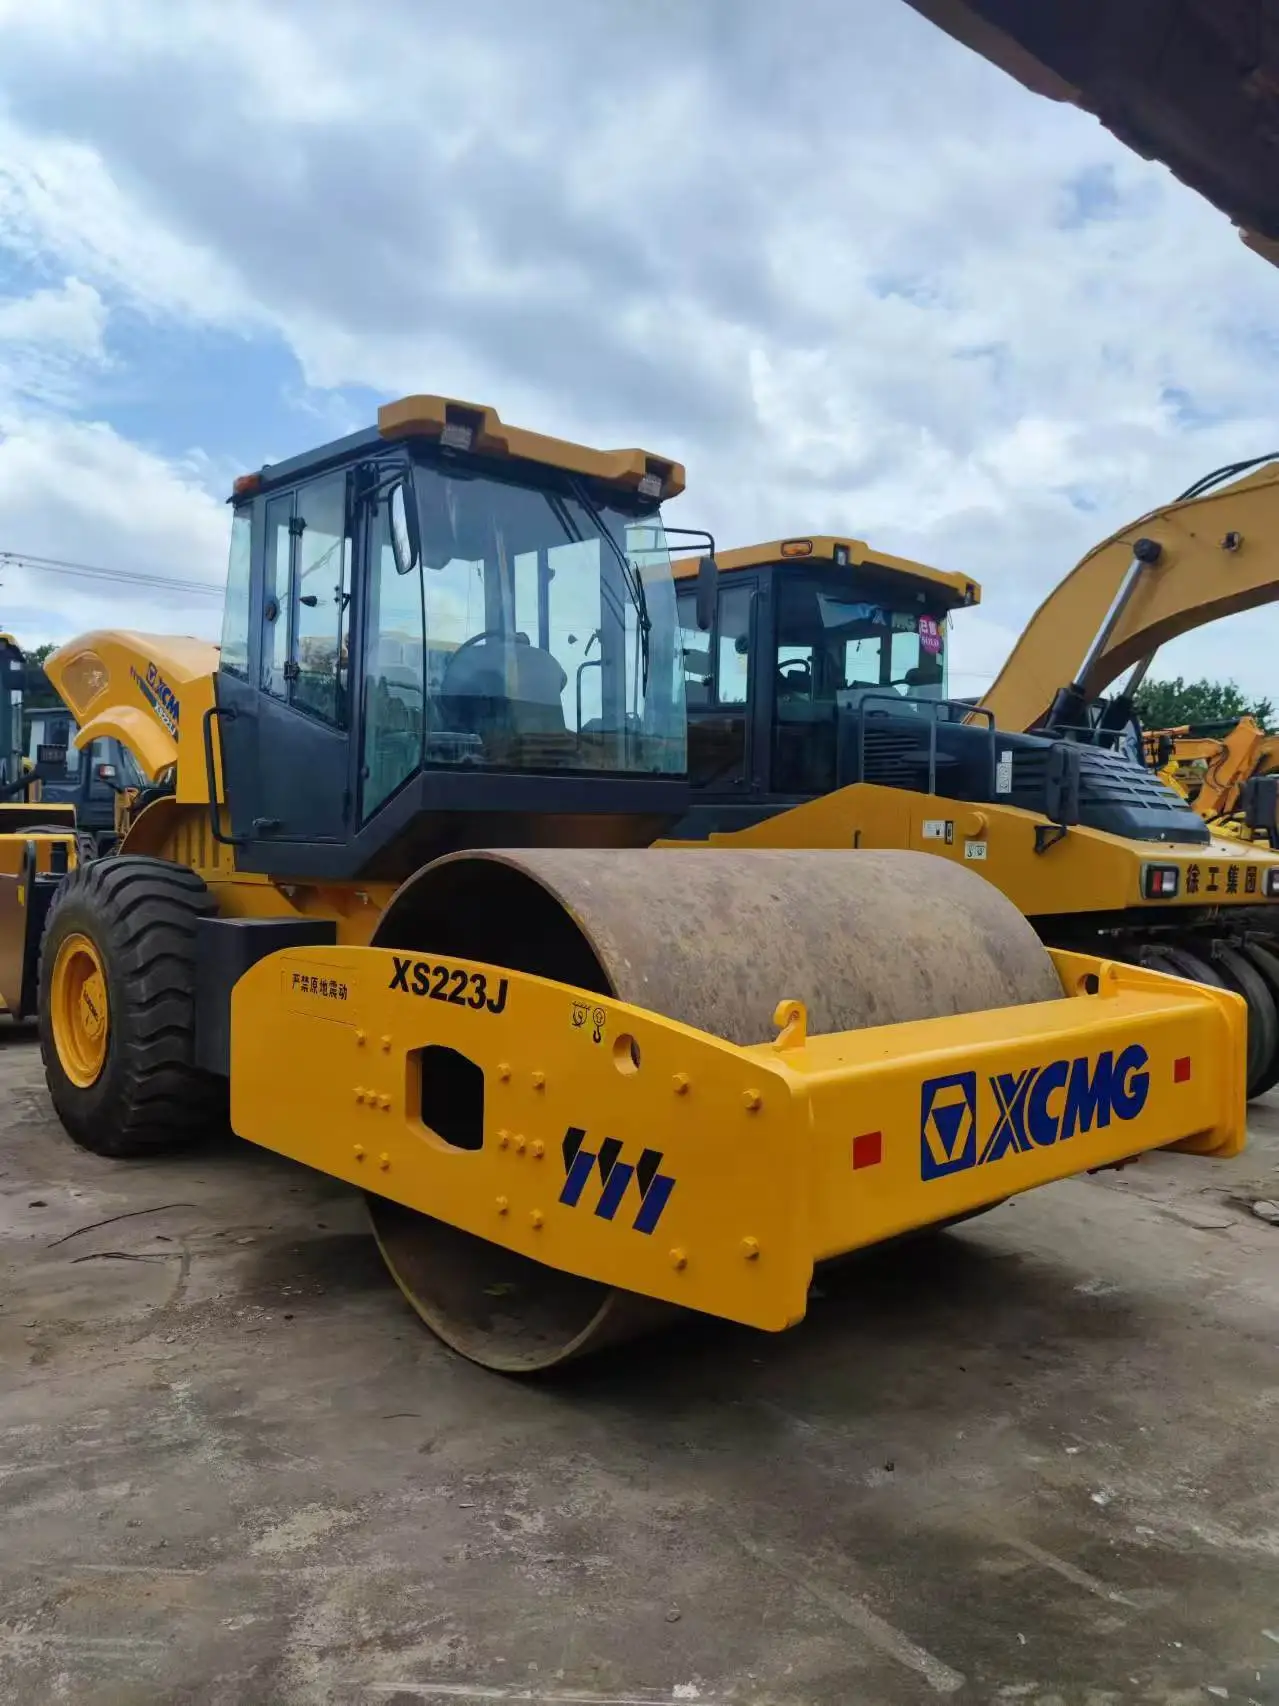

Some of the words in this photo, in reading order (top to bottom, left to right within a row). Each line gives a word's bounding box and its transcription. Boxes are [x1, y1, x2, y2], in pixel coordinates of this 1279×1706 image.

[1186, 863, 1258, 894] 徐工集团
[291, 973, 348, 1001] 严禁原地震动
[388, 956, 509, 1014] XS223J
[976, 1044, 1150, 1167] XCMG
